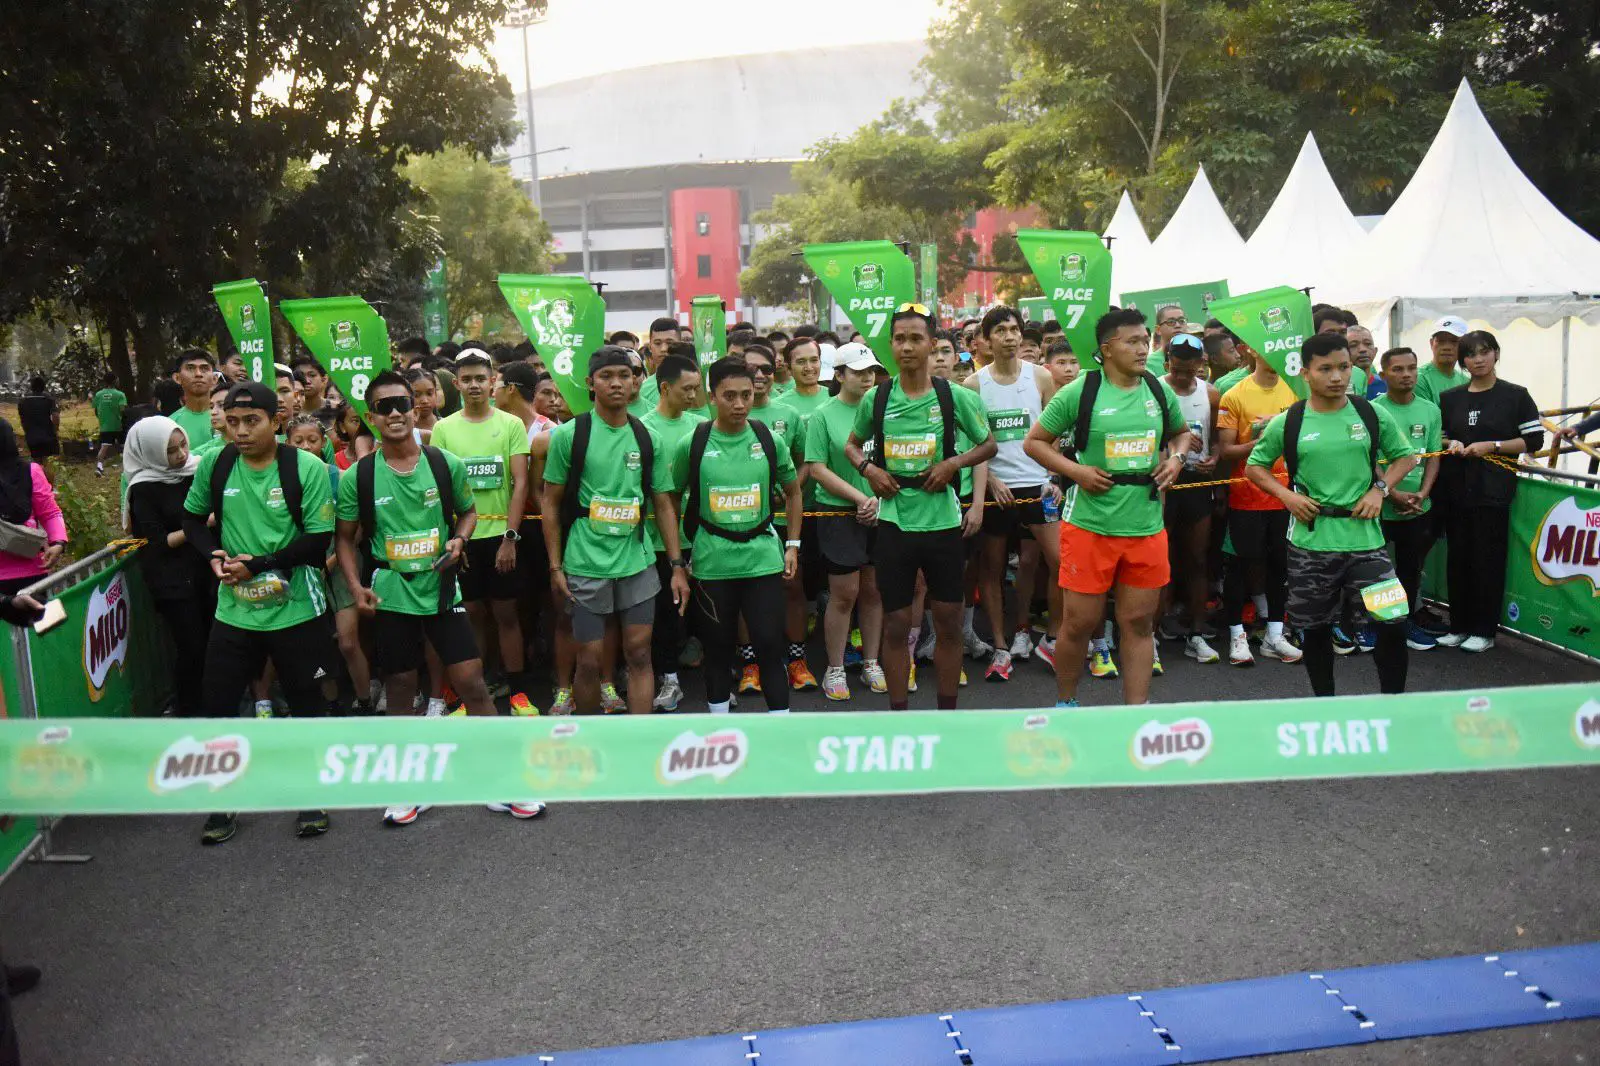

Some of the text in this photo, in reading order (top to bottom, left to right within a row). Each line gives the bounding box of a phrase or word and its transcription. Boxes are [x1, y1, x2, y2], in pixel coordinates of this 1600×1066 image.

[850, 296, 895, 311] PACE
[1053, 288, 1093, 300] PACE
[866, 313, 887, 338] 7
[1066, 305, 1085, 329] 7
[241, 339, 264, 353] PACE
[538, 334, 584, 347] PACE
[1264, 335, 1304, 354] PACE
[330, 356, 373, 372] PACE
[553, 348, 576, 376] 6
[700, 351, 718, 364] PACE
[1284, 351, 1302, 377] 8
[252, 357, 263, 383] 8
[350, 373, 370, 400] 8
[996, 417, 1024, 428] 50344
[891, 443, 929, 456] PACER
[1114, 441, 1150, 454] PACER
[467, 464, 497, 476] 51393
[717, 495, 755, 507] PACER
[597, 506, 635, 520] PACER
[394, 540, 434, 557] PACER
[1542, 524, 1600, 567] MIL
[237, 584, 275, 599] PACER
[89, 598, 127, 675] MILO
[1141, 731, 1205, 758] MILO
[1277, 718, 1391, 758] START
[318, 742, 458, 785] START
[667, 744, 740, 773] MILO
[814, 734, 941, 775] START
[163, 750, 241, 780] MILO
